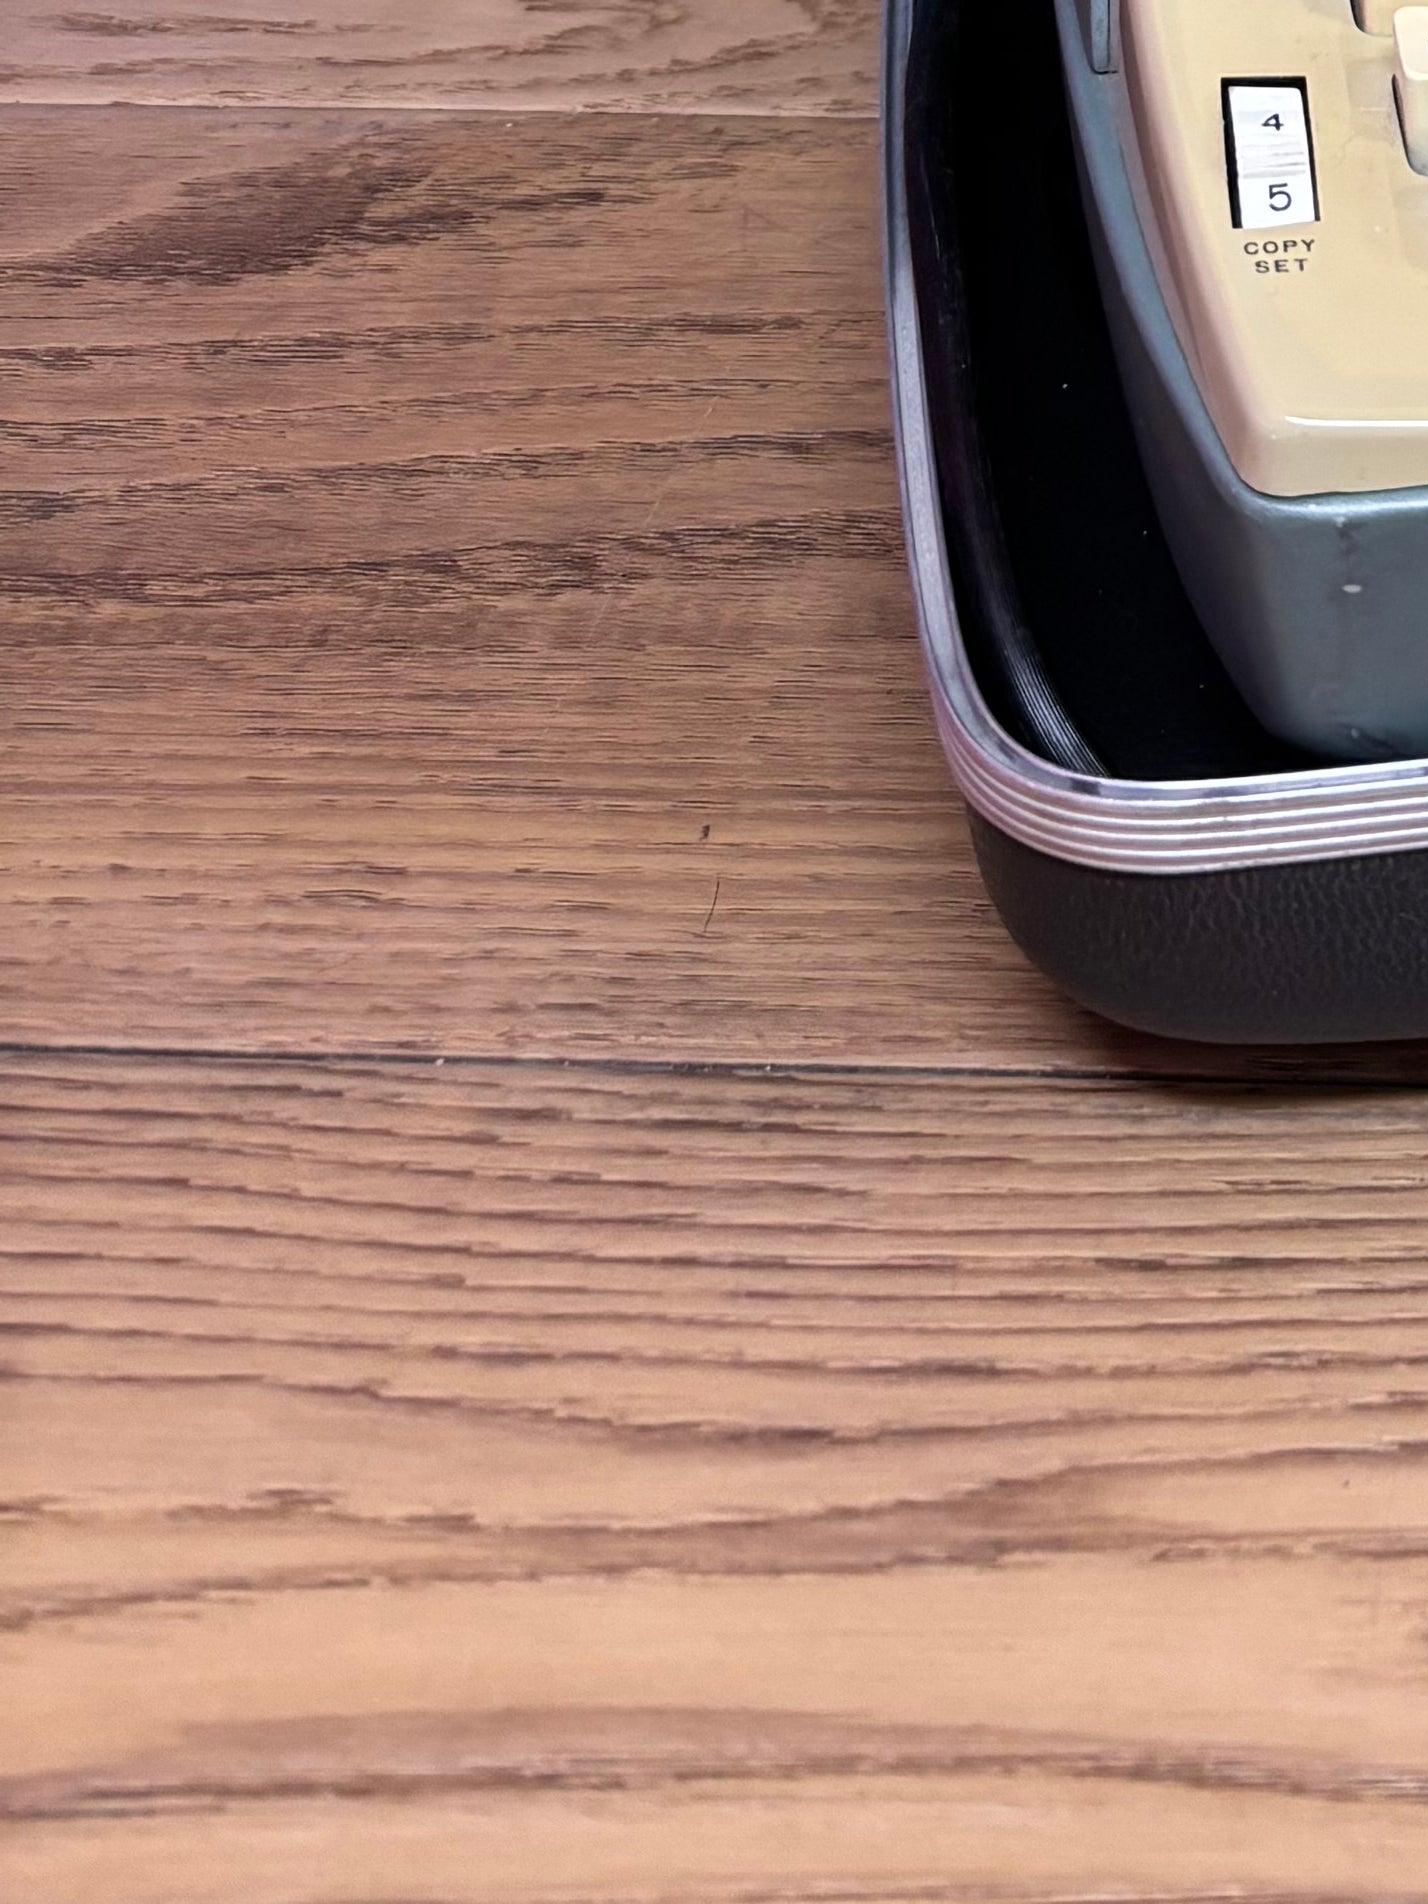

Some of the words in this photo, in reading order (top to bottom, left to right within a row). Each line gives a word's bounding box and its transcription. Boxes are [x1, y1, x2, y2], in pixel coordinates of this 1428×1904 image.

[1261, 113, 1284, 132] 4
[1268, 182, 1292, 212] 5
[1243, 238, 1315, 256] COPY
[1254, 258, 1308, 274] SET
